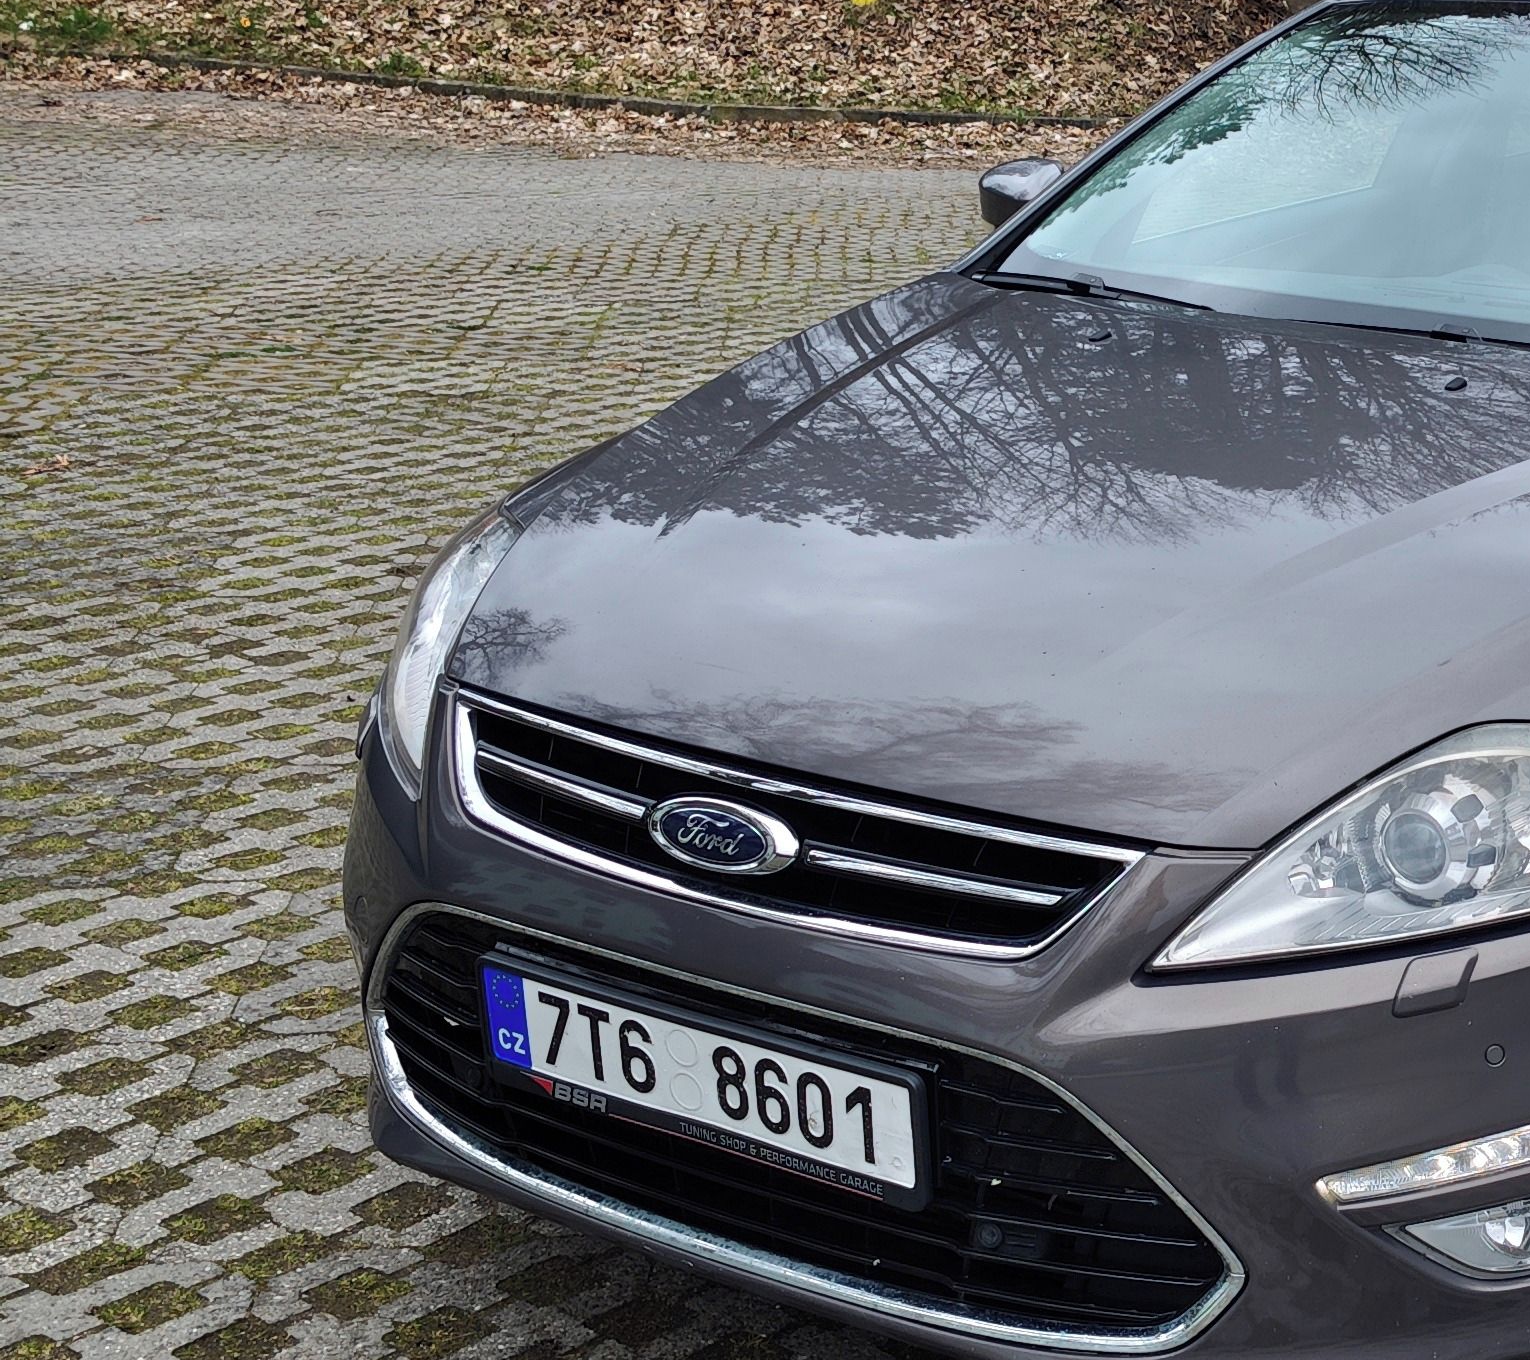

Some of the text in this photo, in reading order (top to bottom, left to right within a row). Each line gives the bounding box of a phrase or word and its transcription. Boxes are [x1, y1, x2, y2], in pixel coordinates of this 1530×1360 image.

[677, 813, 745, 856] Ford
[498, 1027, 526, 1055] CZ
[537, 990, 876, 1165] 7T6 8601
[554, 1082, 607, 1113] BSR
[679, 1121, 884, 1197] TUNING SHOP & PERFORMANCE GARAGE
